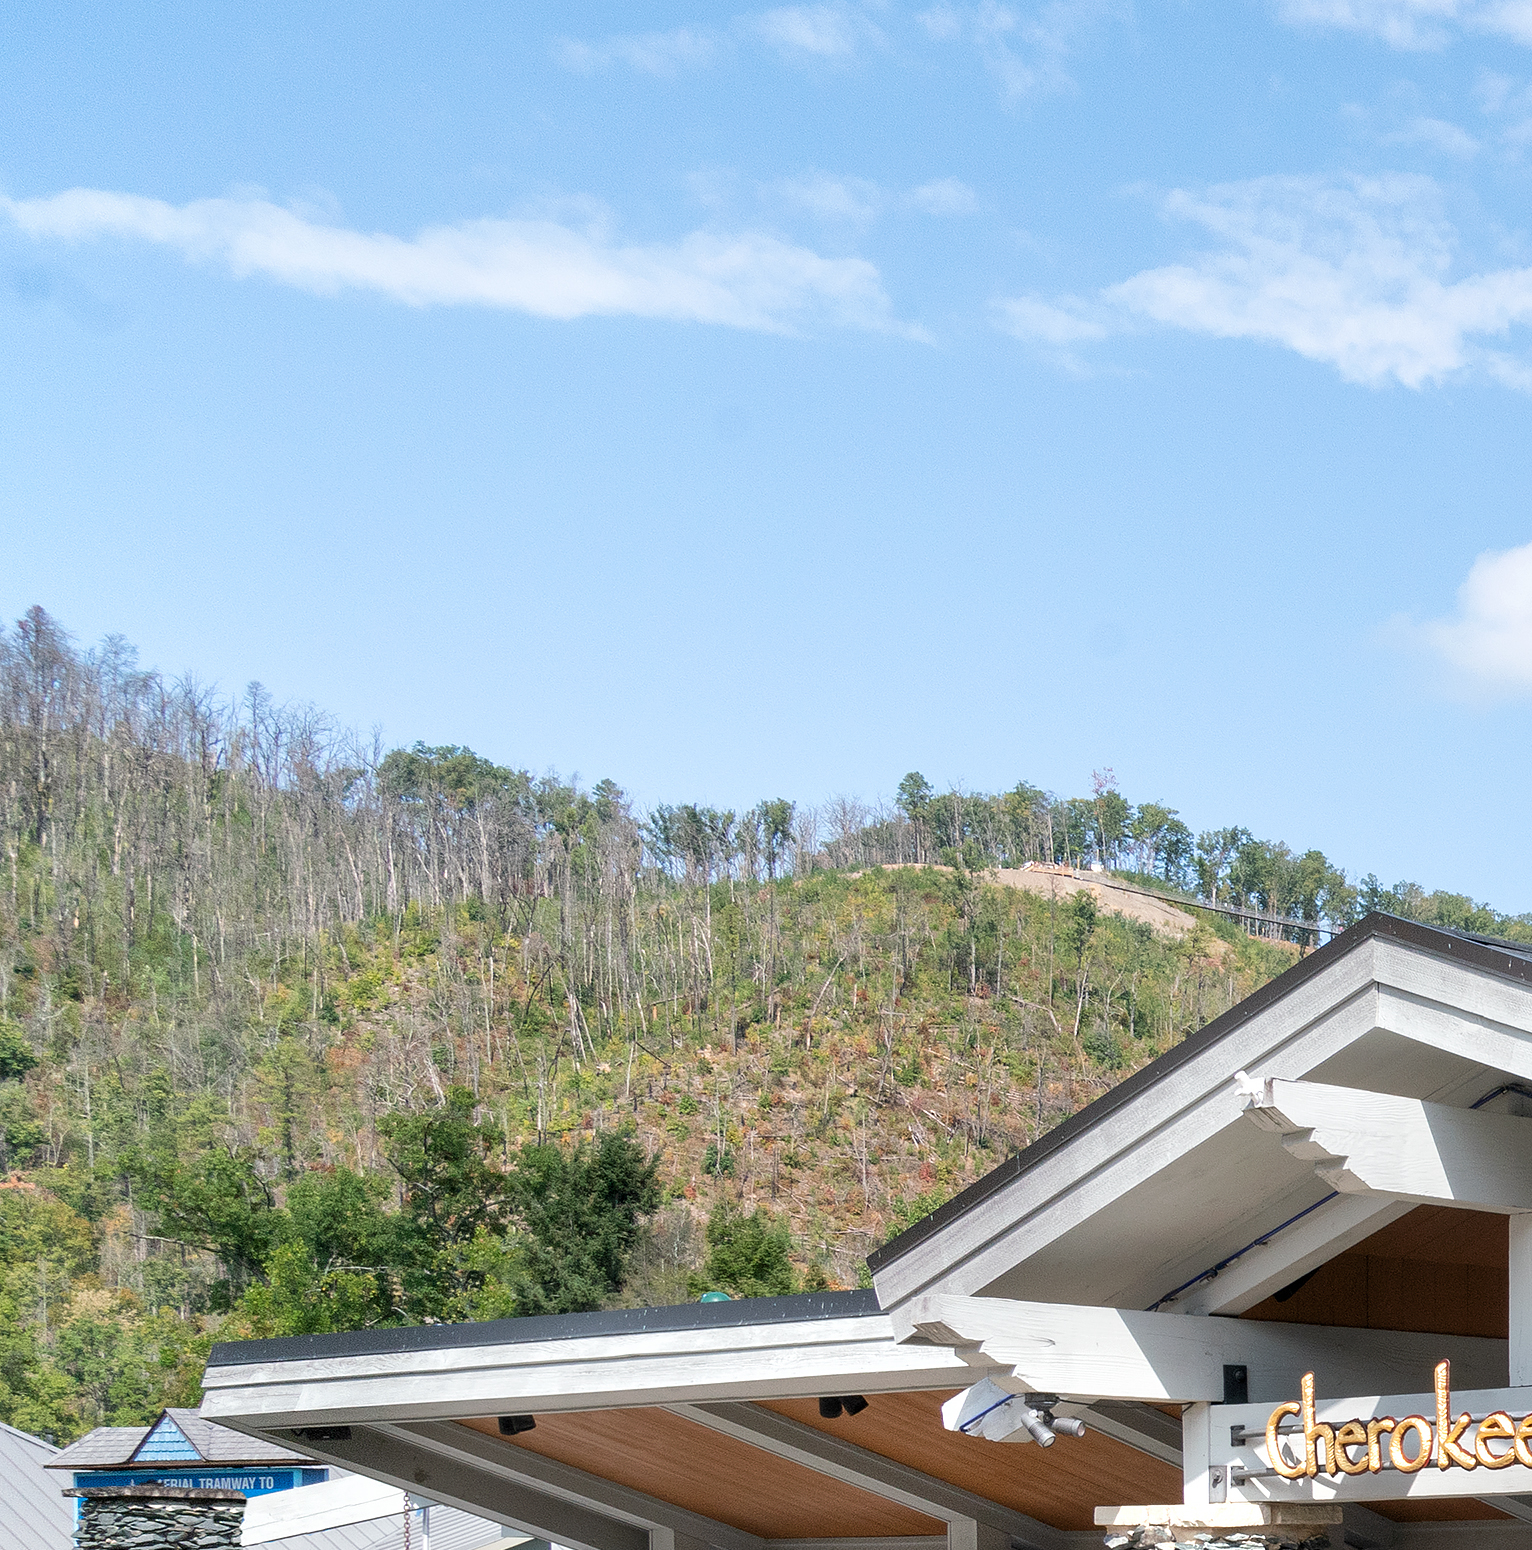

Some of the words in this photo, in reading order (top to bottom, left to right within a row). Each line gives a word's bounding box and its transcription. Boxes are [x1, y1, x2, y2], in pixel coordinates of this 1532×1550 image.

[157, 1478, 194, 1488] ERIAL
[199, 1476, 256, 1490] TRAMWAY
[258, 1476, 275, 1490] TO
